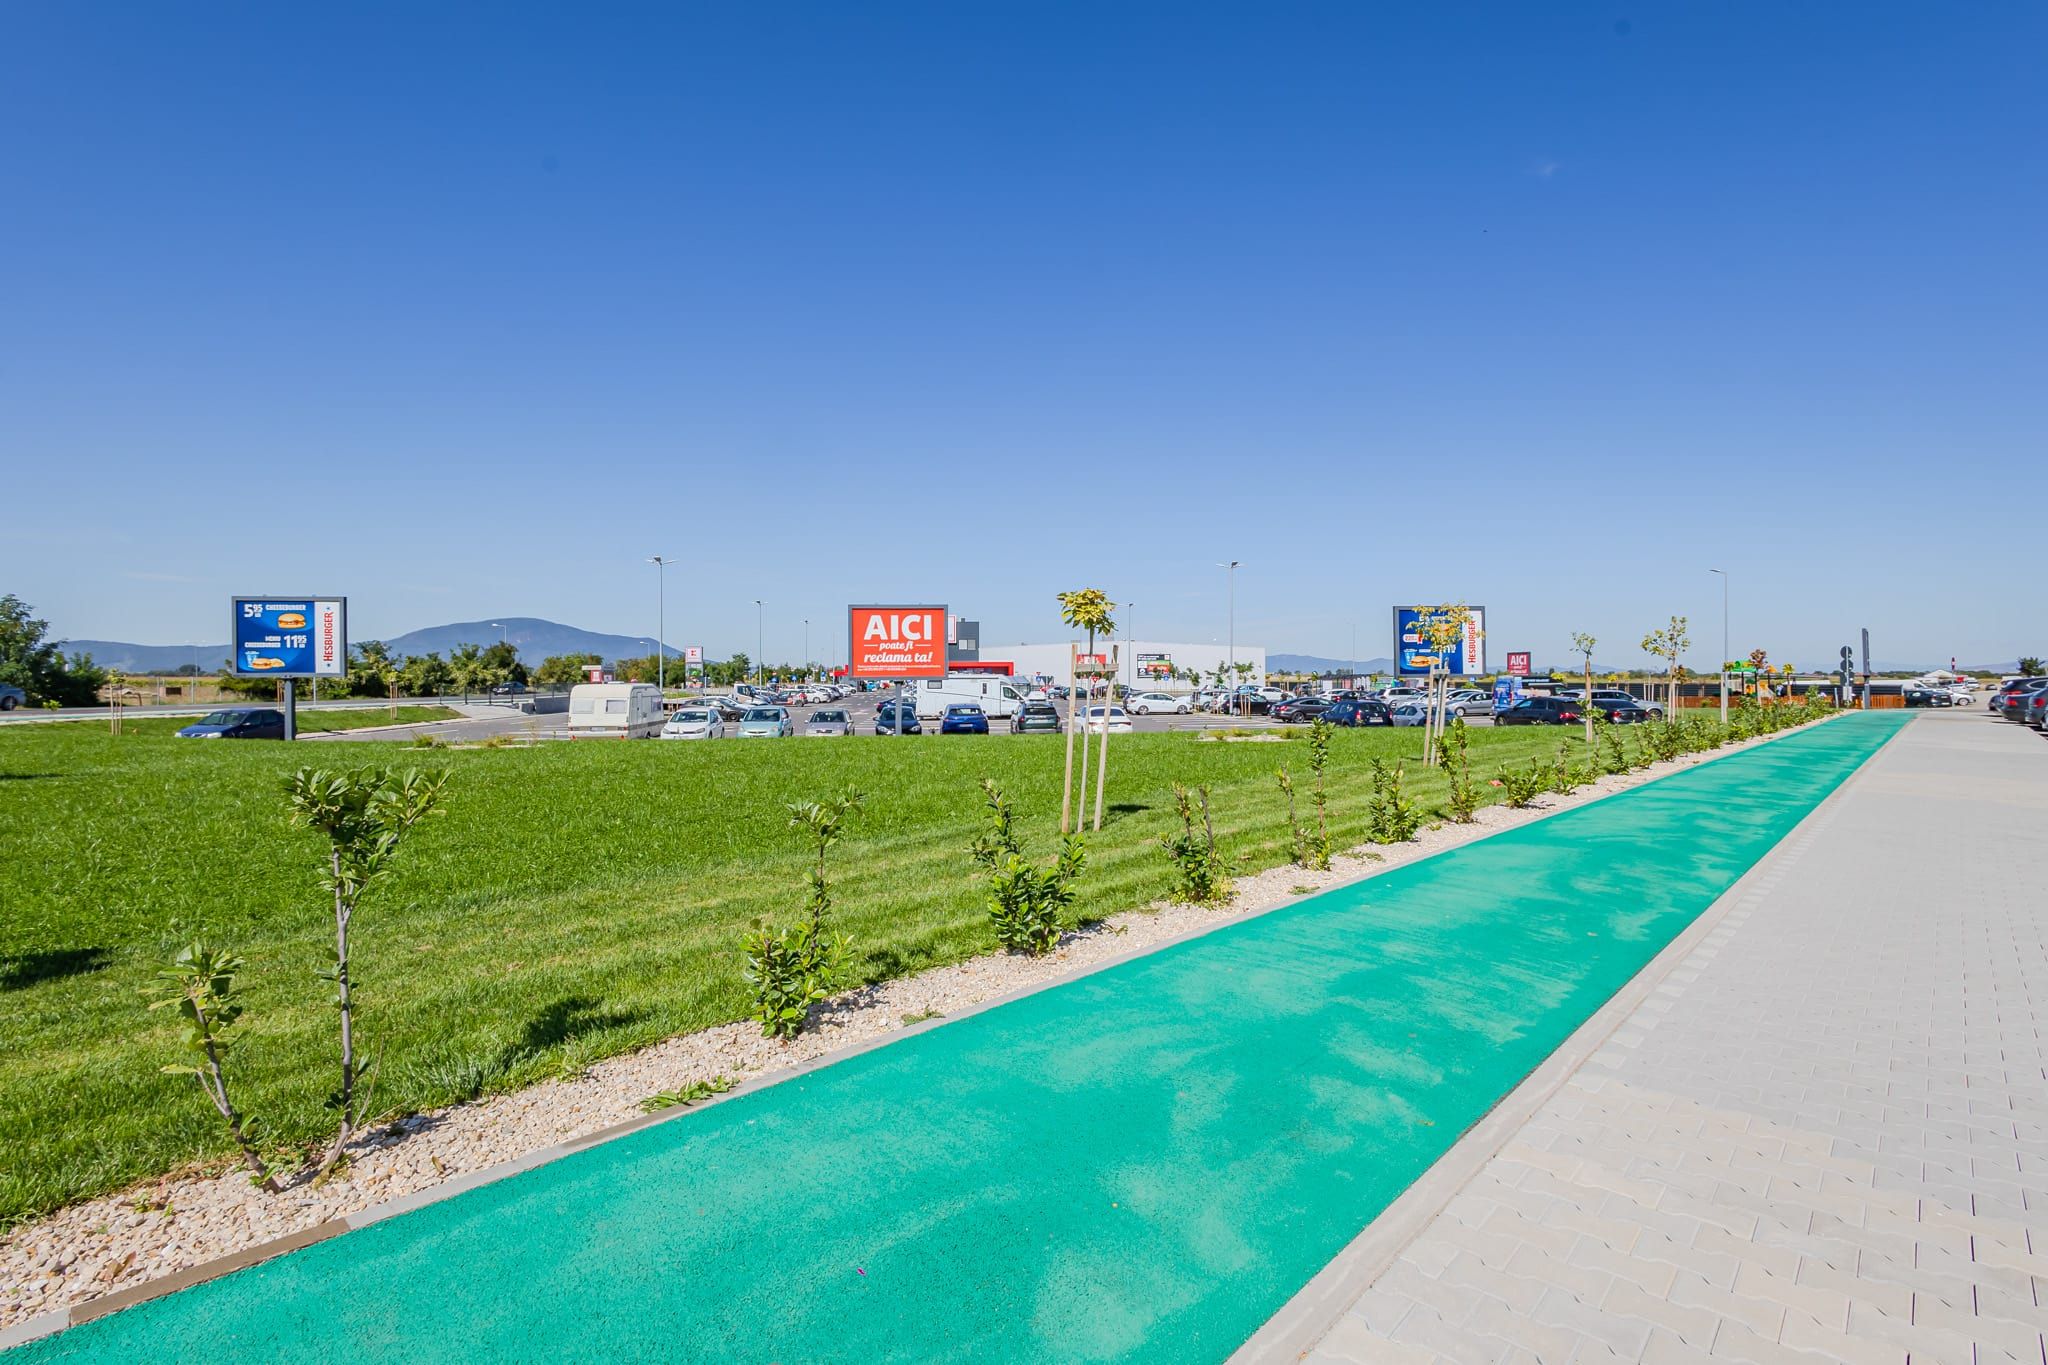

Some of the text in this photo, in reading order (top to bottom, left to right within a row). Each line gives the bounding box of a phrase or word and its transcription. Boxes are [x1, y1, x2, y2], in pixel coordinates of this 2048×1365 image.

[864, 614, 932, 640] AICI
[323, 611, 333, 662] HESBURGER
[879, 642, 905, 651] poate
[864, 652, 933, 663] reclama ta!
[1510, 655, 1527, 666] AICI
